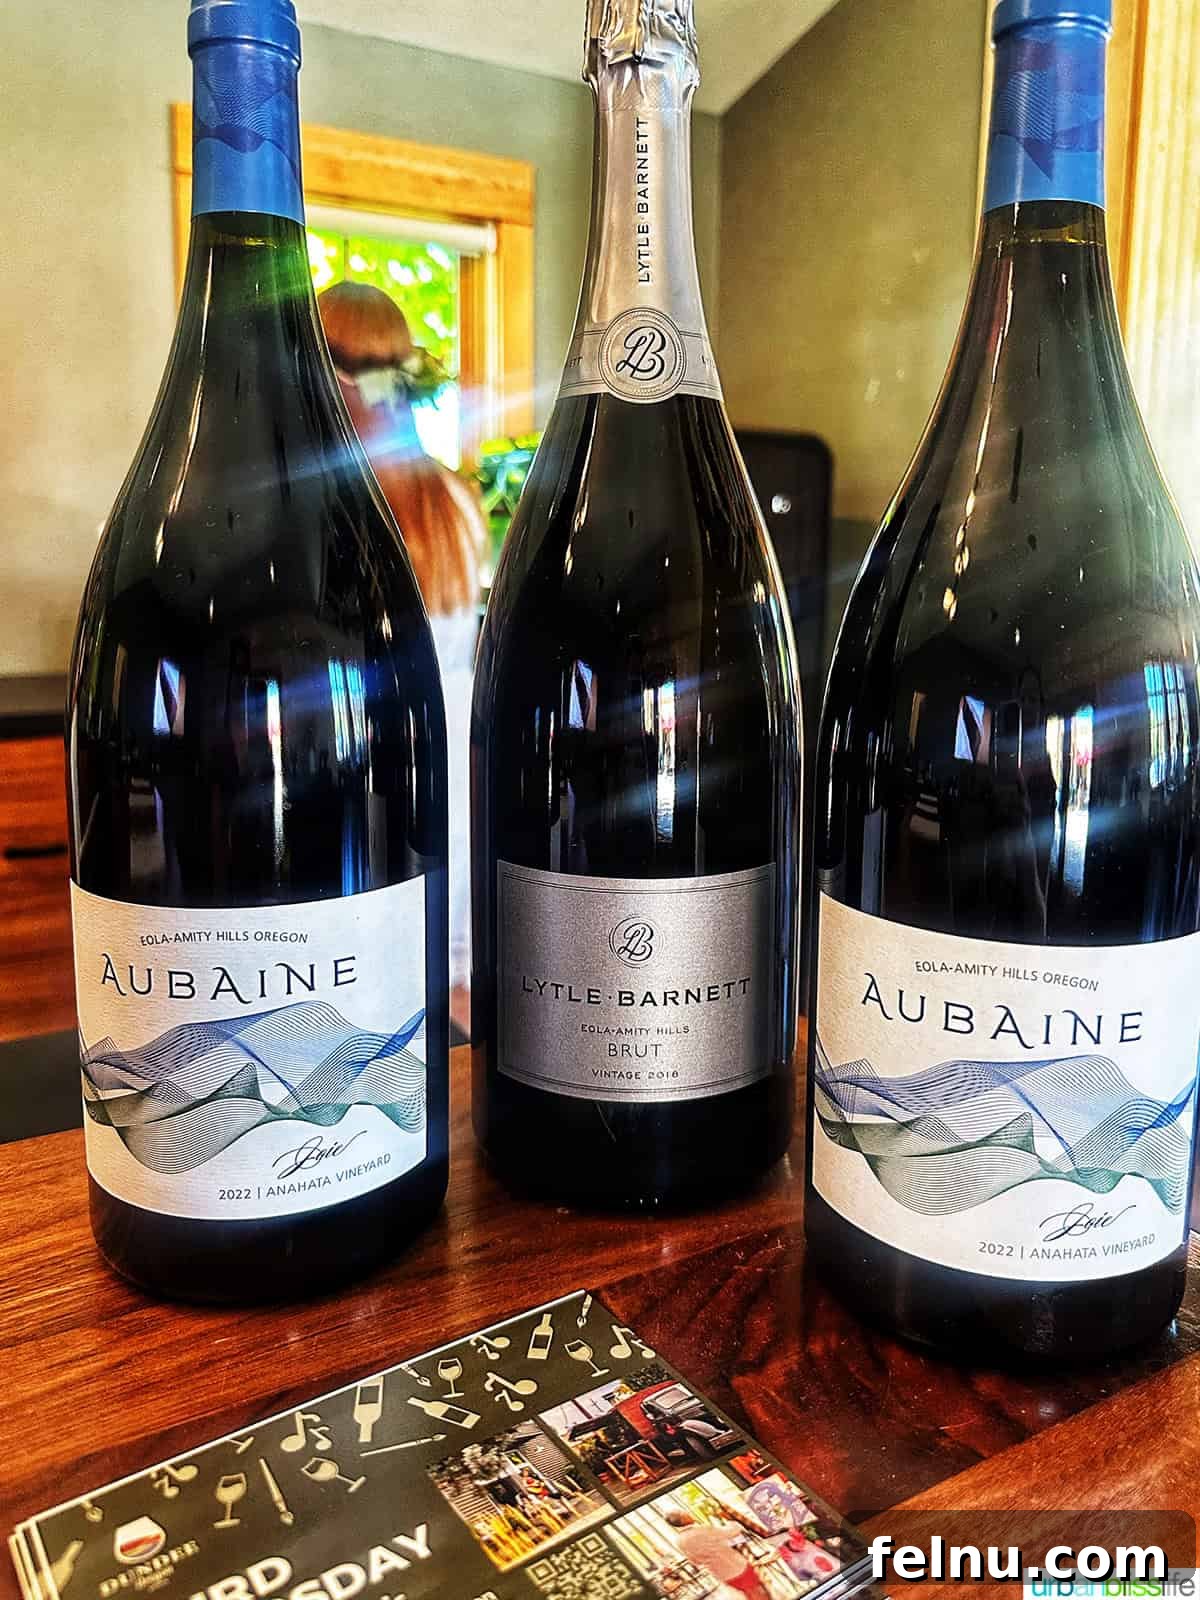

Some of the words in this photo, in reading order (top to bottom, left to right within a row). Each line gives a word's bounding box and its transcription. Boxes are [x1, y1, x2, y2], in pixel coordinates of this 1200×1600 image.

[140, 931, 212, 946] EOLA-AMITY
[216, 930, 249, 943] HILLS
[253, 931, 309, 944] OREGON
[101, 953, 358, 1004] AUBAINE
[915, 960, 998, 977] EOLA-AMITY
[1002, 968, 1039, 982] HILLS
[1043, 972, 1100, 993] OREGON
[861, 972, 1144, 1050] AUBAINE
[656, 1025, 690, 1035] HILLS
[608, 1043, 662, 1058] BRUT
[591, 1069, 641, 1080] VINTAGE
[218, 1188, 252, 1201] 2022
[266, 1176, 332, 1198] ANAHATA
[335, 1152, 392, 1184] VINEYARD
[978, 1240, 1015, 1257] 2022
[1030, 1246, 1098, 1261] ANAHATA
[1101, 1233, 1156, 1257] VINEYARD
[190, 1556, 292, 1600] RD
